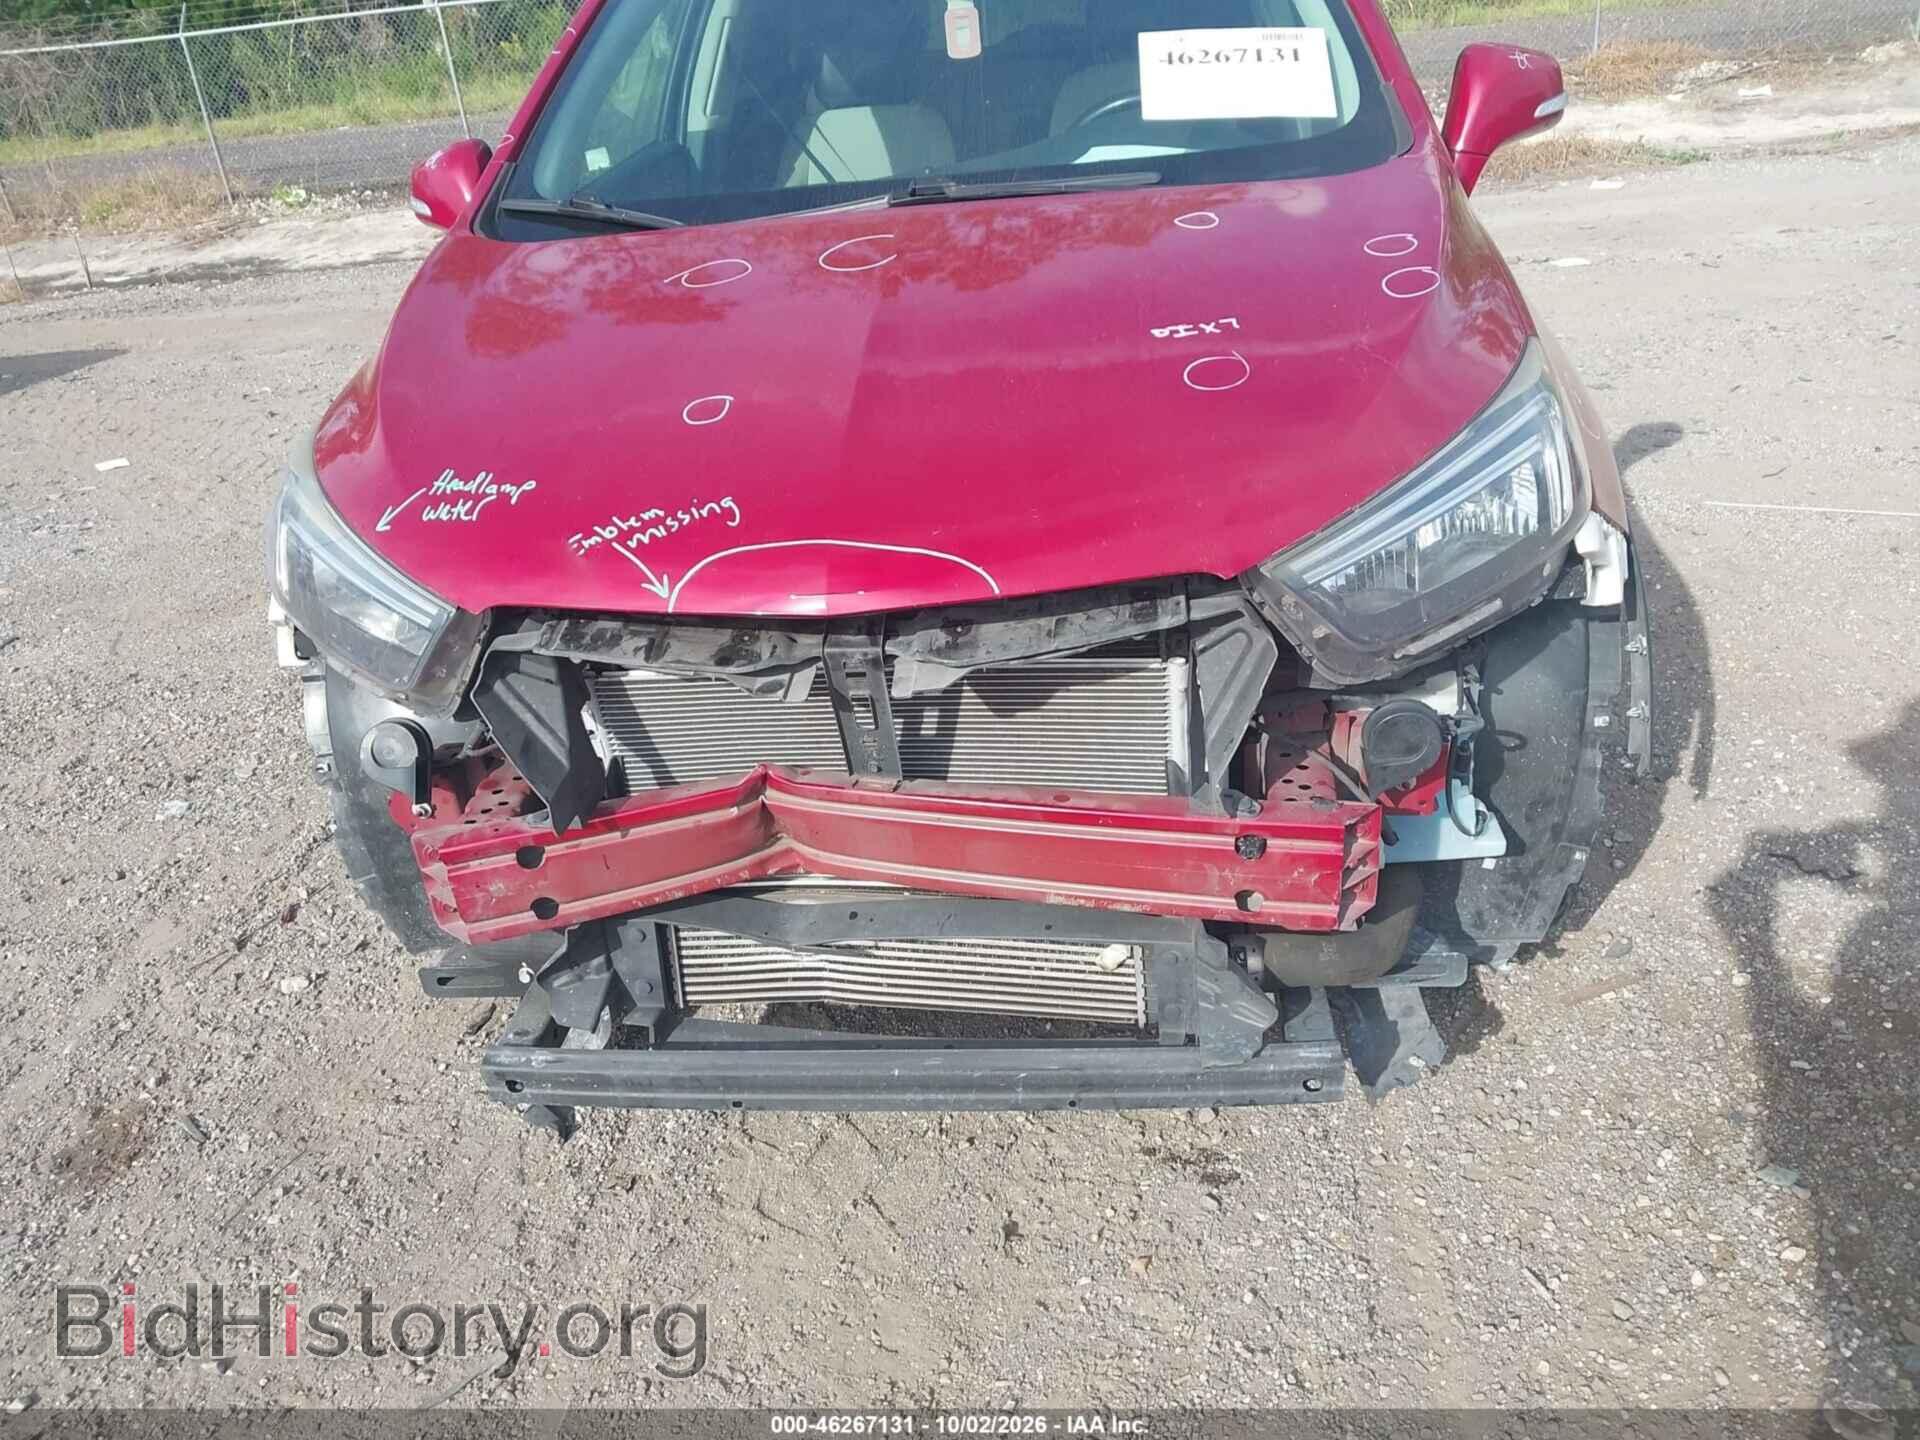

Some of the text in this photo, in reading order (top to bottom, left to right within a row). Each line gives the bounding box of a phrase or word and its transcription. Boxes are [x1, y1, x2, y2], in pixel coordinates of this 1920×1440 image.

[1159, 47, 1302, 66] 46267131
[428, 468, 537, 505] Headlamp
[567, 508, 666, 556] Emblem
[626, 496, 741, 549] missing
